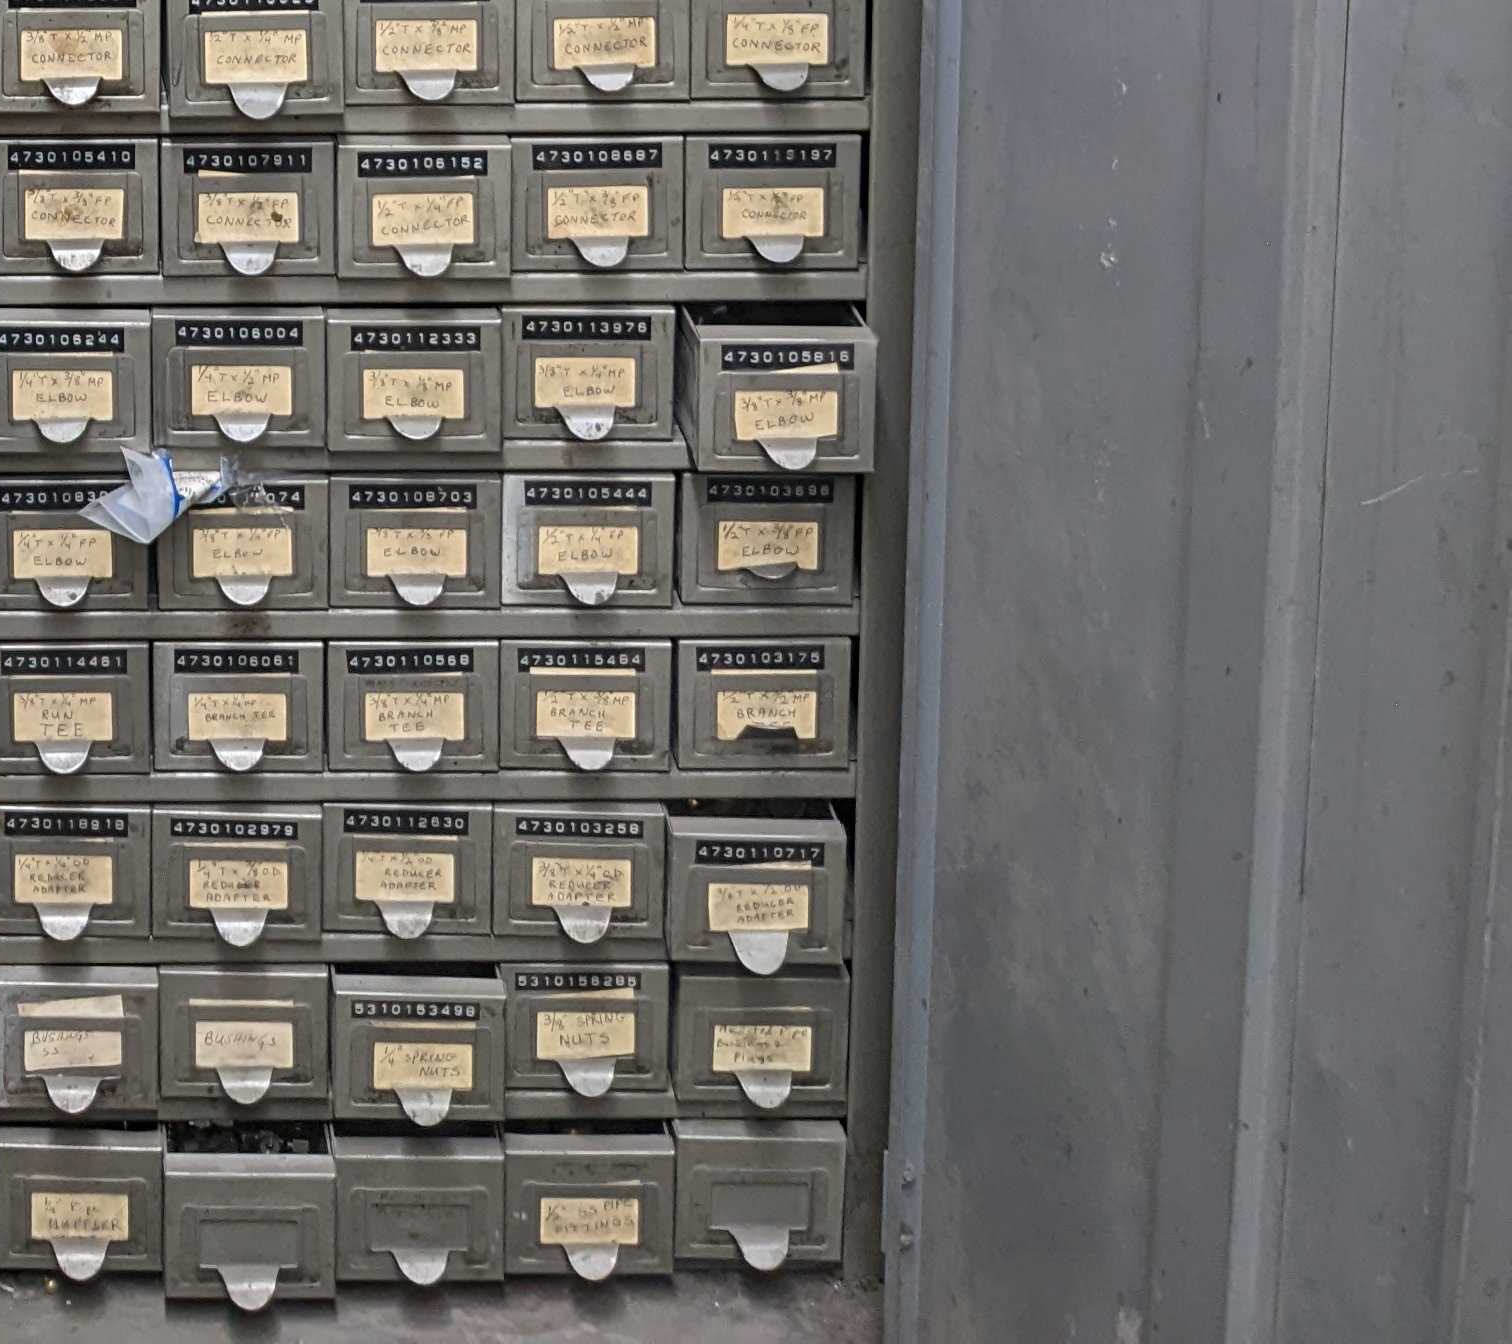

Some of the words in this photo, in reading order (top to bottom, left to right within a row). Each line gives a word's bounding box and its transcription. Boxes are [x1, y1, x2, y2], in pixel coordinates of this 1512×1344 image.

[10, 150, 131, 163] 4730105410
[186, 153, 307, 168] 4730107911
[353, 332, 477, 345] 4730112333
[351, 492, 473, 505] 4730108703
[526, 487, 648, 500] 4730105444
[699, 652, 820, 665] 4730103175
[173, 822, 294, 837] 4730102979
[698, 845, 820, 860] 4730110717
